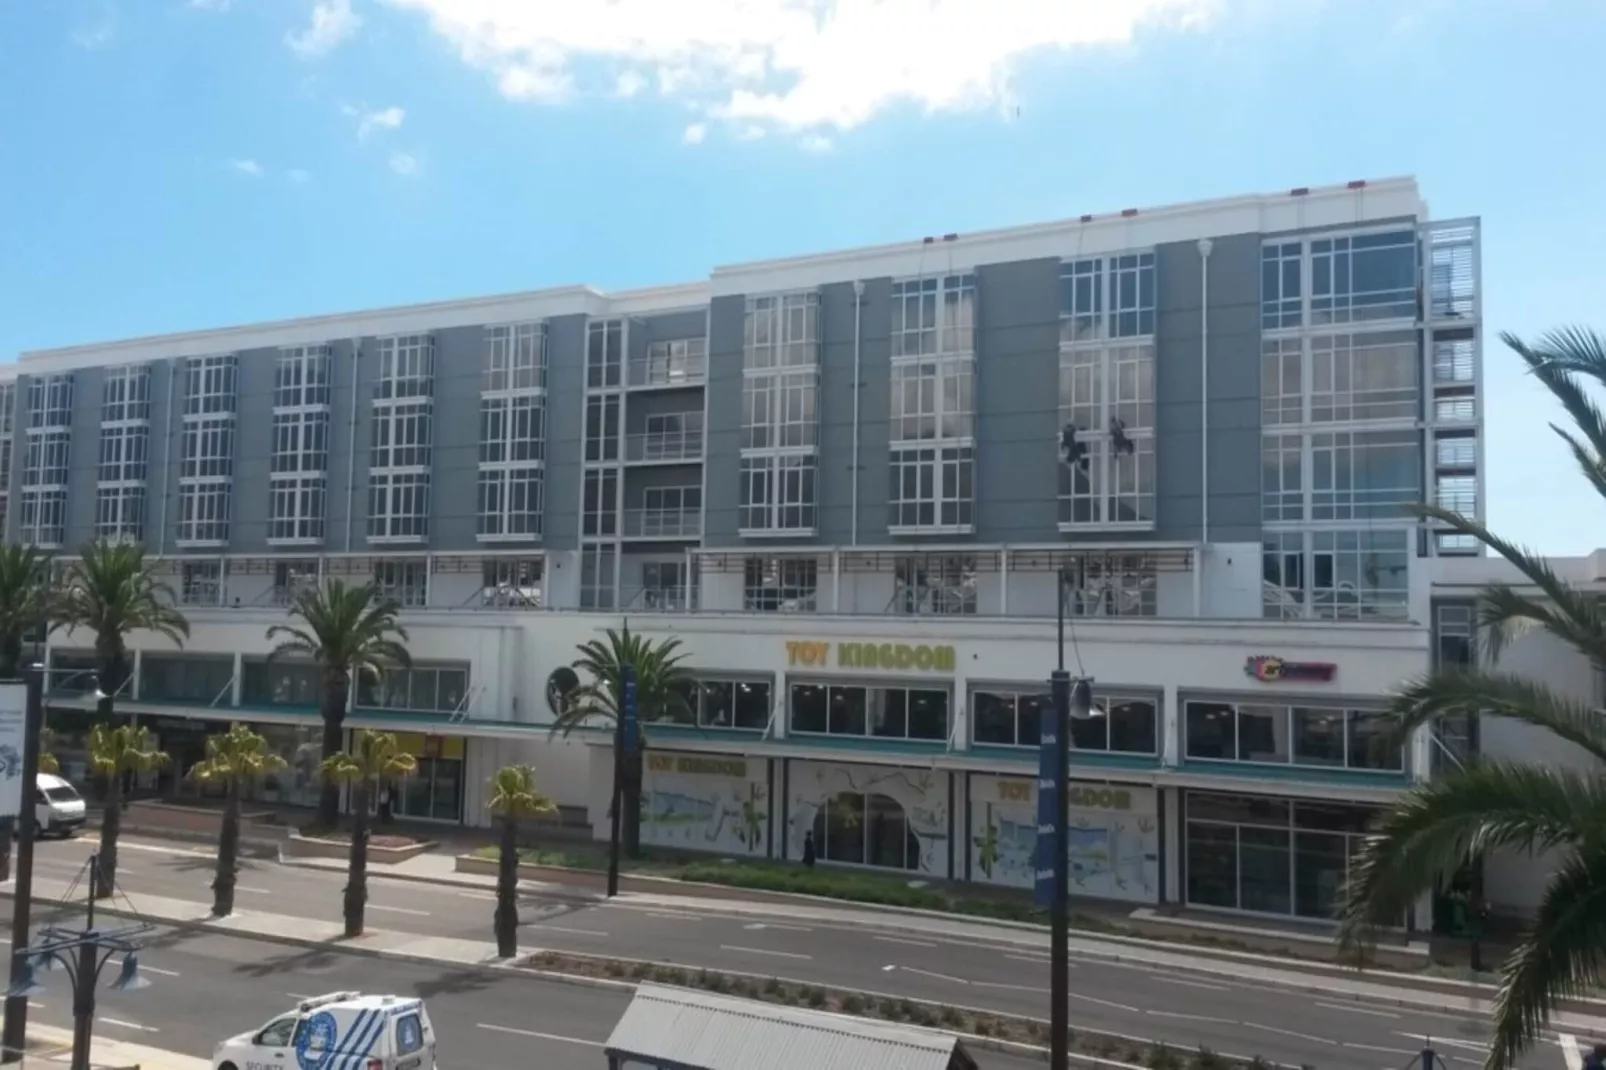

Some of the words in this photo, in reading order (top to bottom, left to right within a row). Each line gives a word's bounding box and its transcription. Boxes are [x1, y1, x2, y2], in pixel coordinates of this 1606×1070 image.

[785, 640, 829, 668] TOY
[837, 642, 956, 672] KINGDOM
[677, 757, 746, 778] KINGDOM
[998, 781, 1031, 801] TOY
[1069, 787, 1131, 809] GDOM
